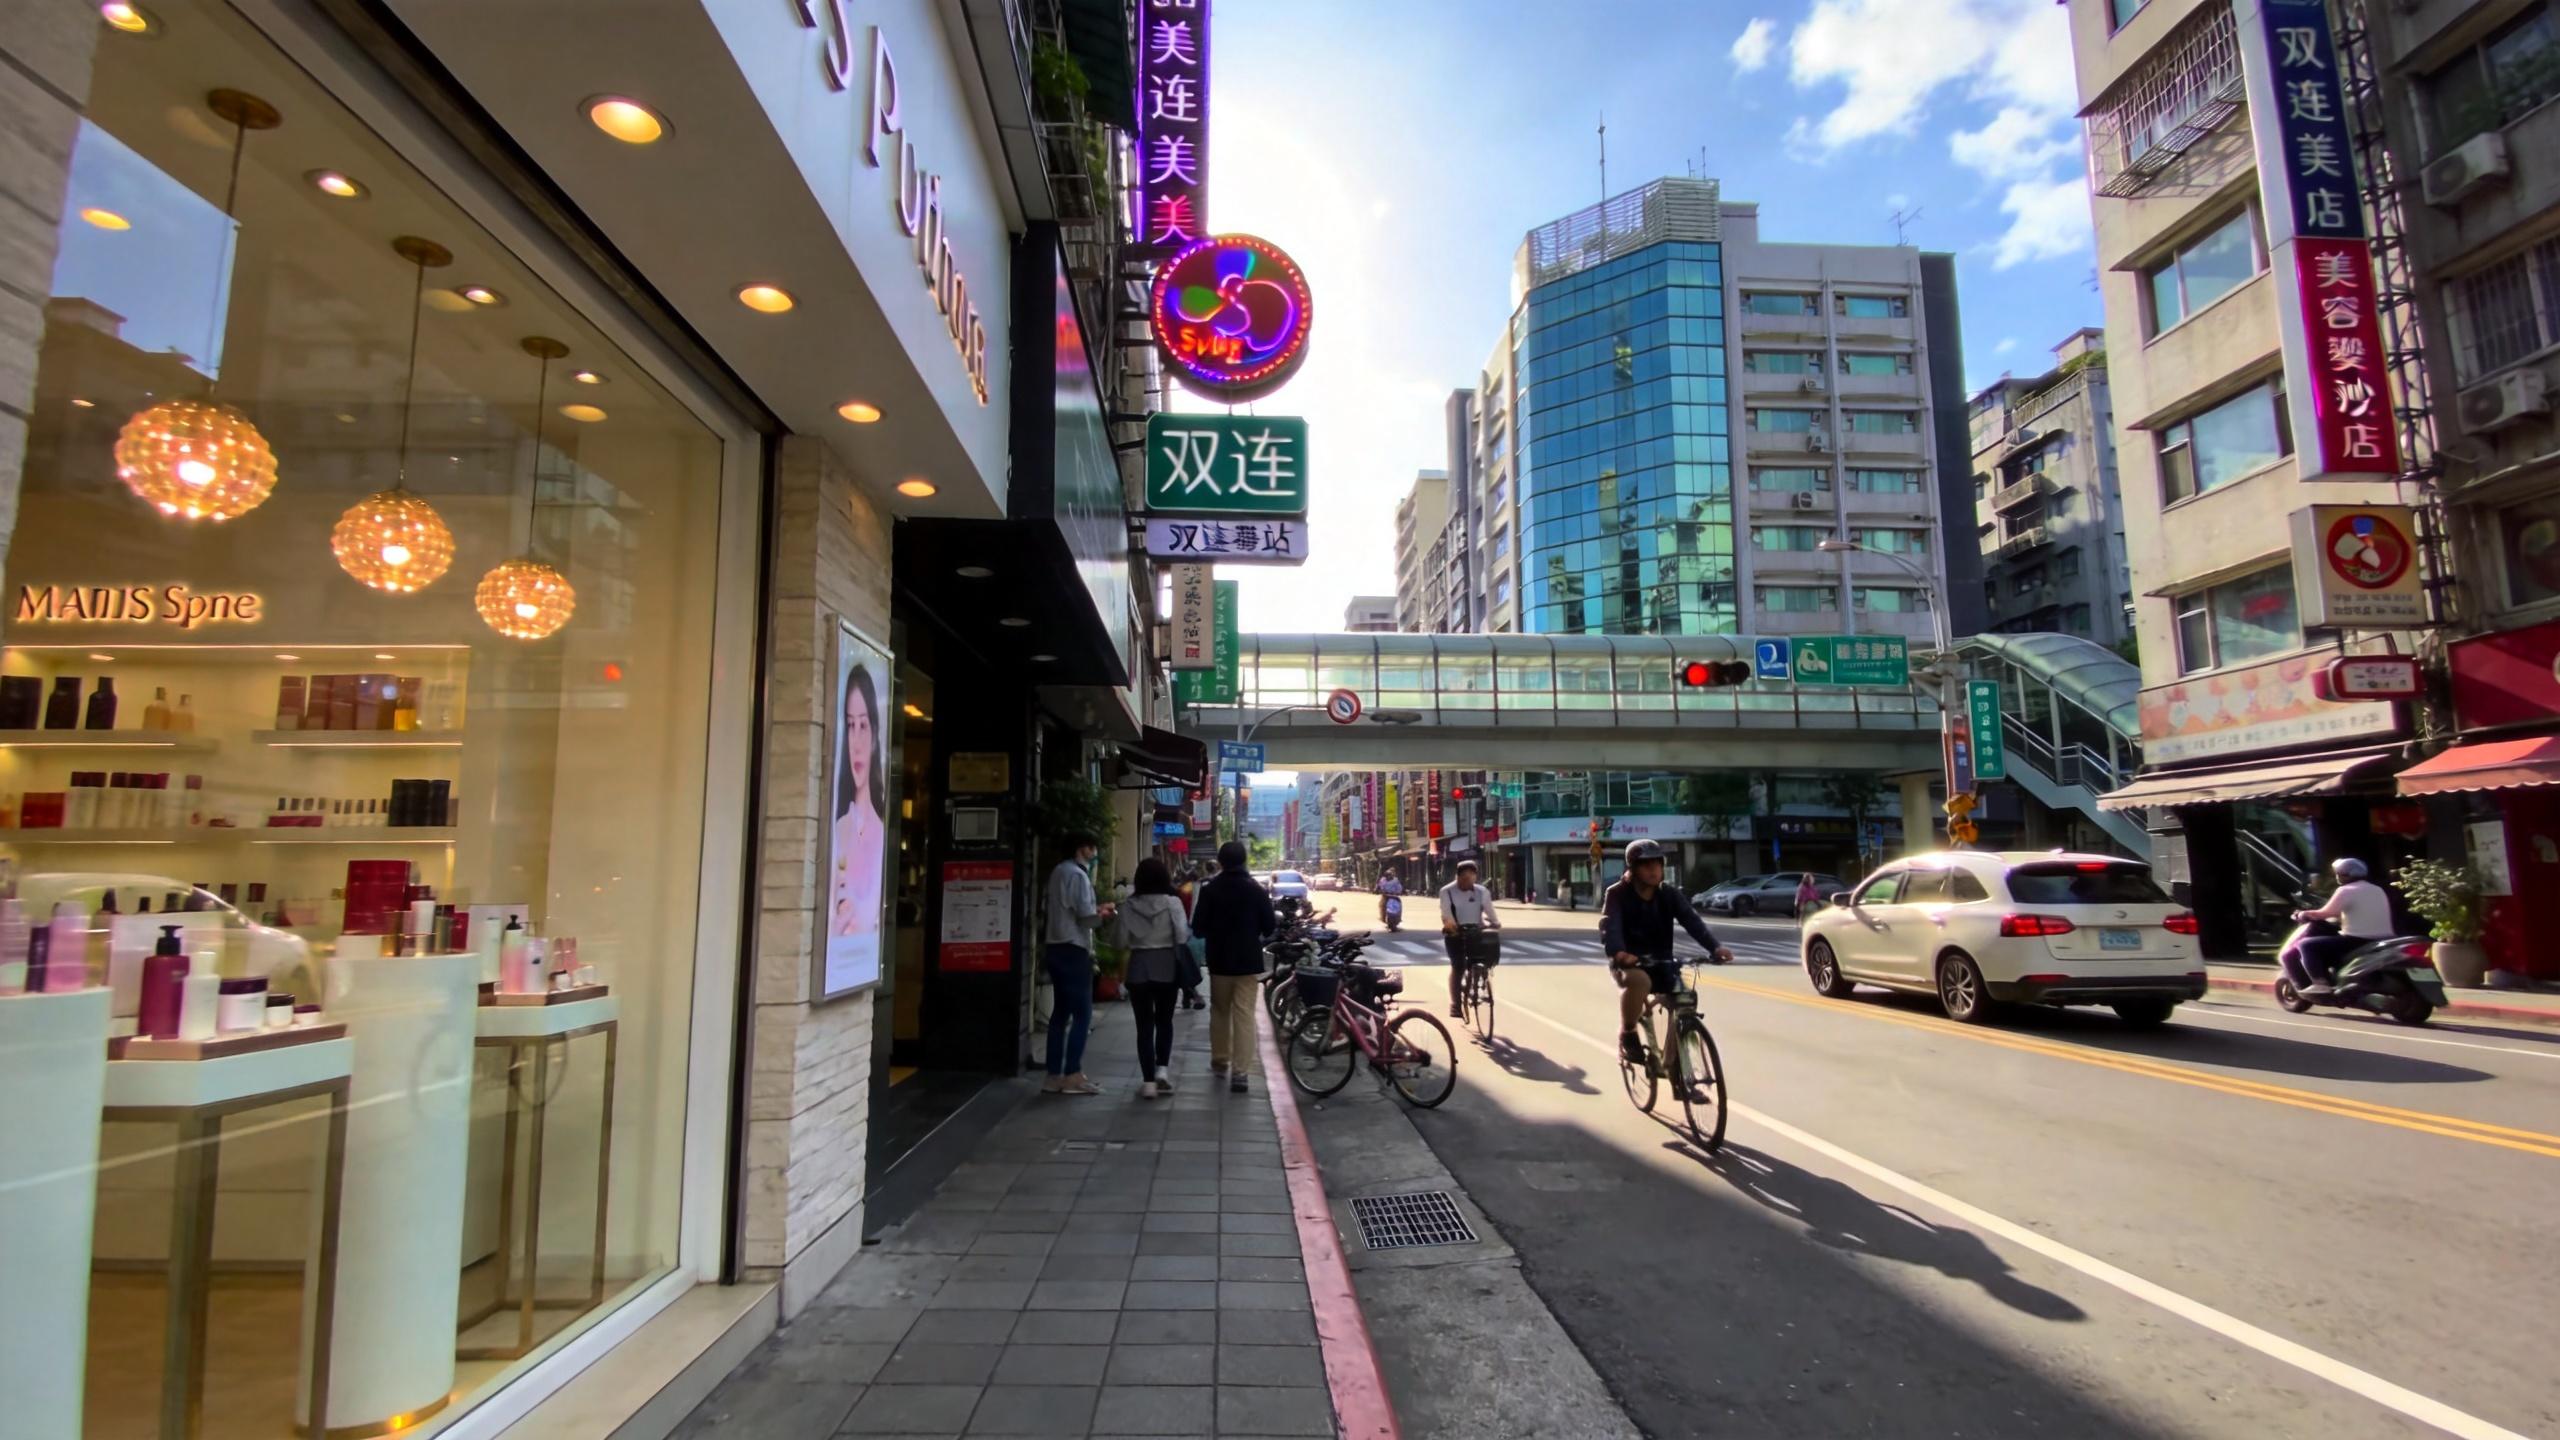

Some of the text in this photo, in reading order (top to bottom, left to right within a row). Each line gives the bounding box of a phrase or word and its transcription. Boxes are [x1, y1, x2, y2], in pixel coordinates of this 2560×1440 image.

[1149, 0, 1199, 245] 美连美美
[2268, 0, 2347, 228] 双连美店
[1160, 428, 1297, 496] 双连
